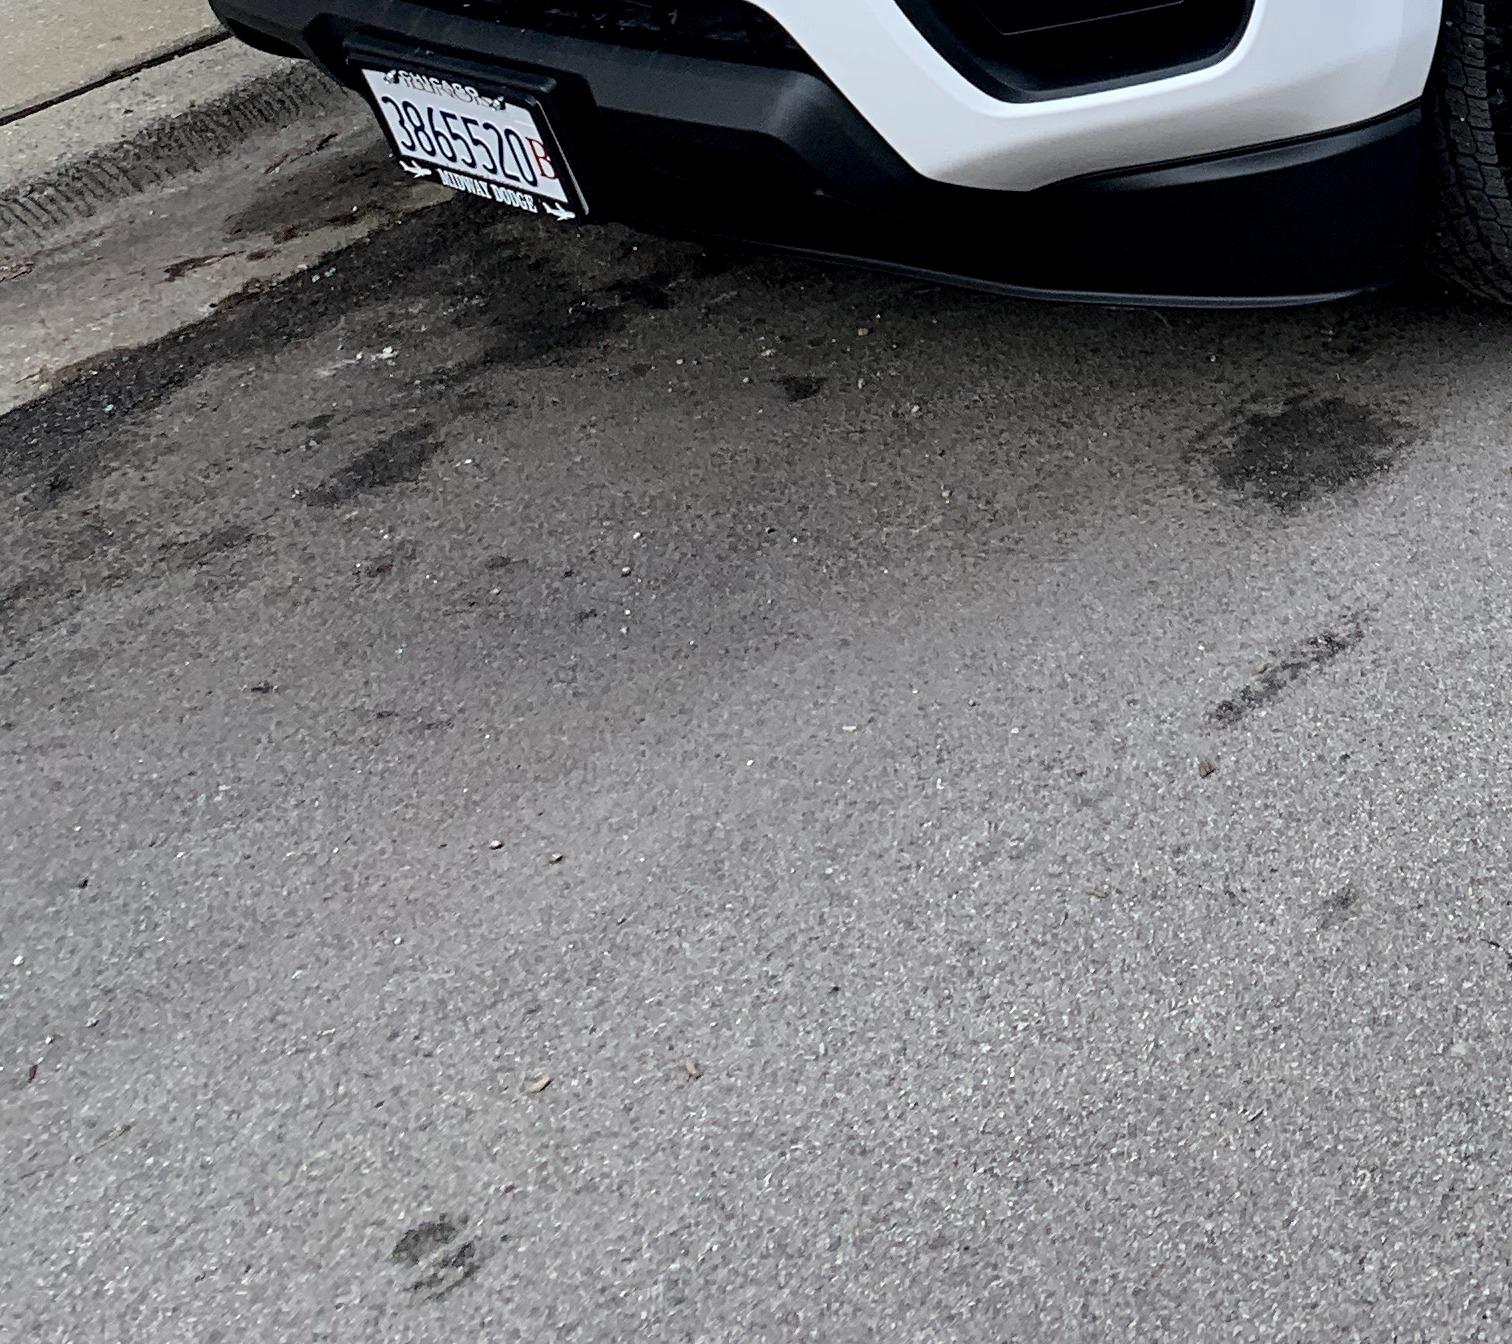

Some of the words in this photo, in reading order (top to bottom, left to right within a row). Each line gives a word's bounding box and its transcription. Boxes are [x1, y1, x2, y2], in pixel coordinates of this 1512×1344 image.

[381, 95, 539, 188] 3865520
[524, 136, 559, 181] B
[436, 167, 493, 200] MIDWAY
[489, 183, 538, 213] DODGE
